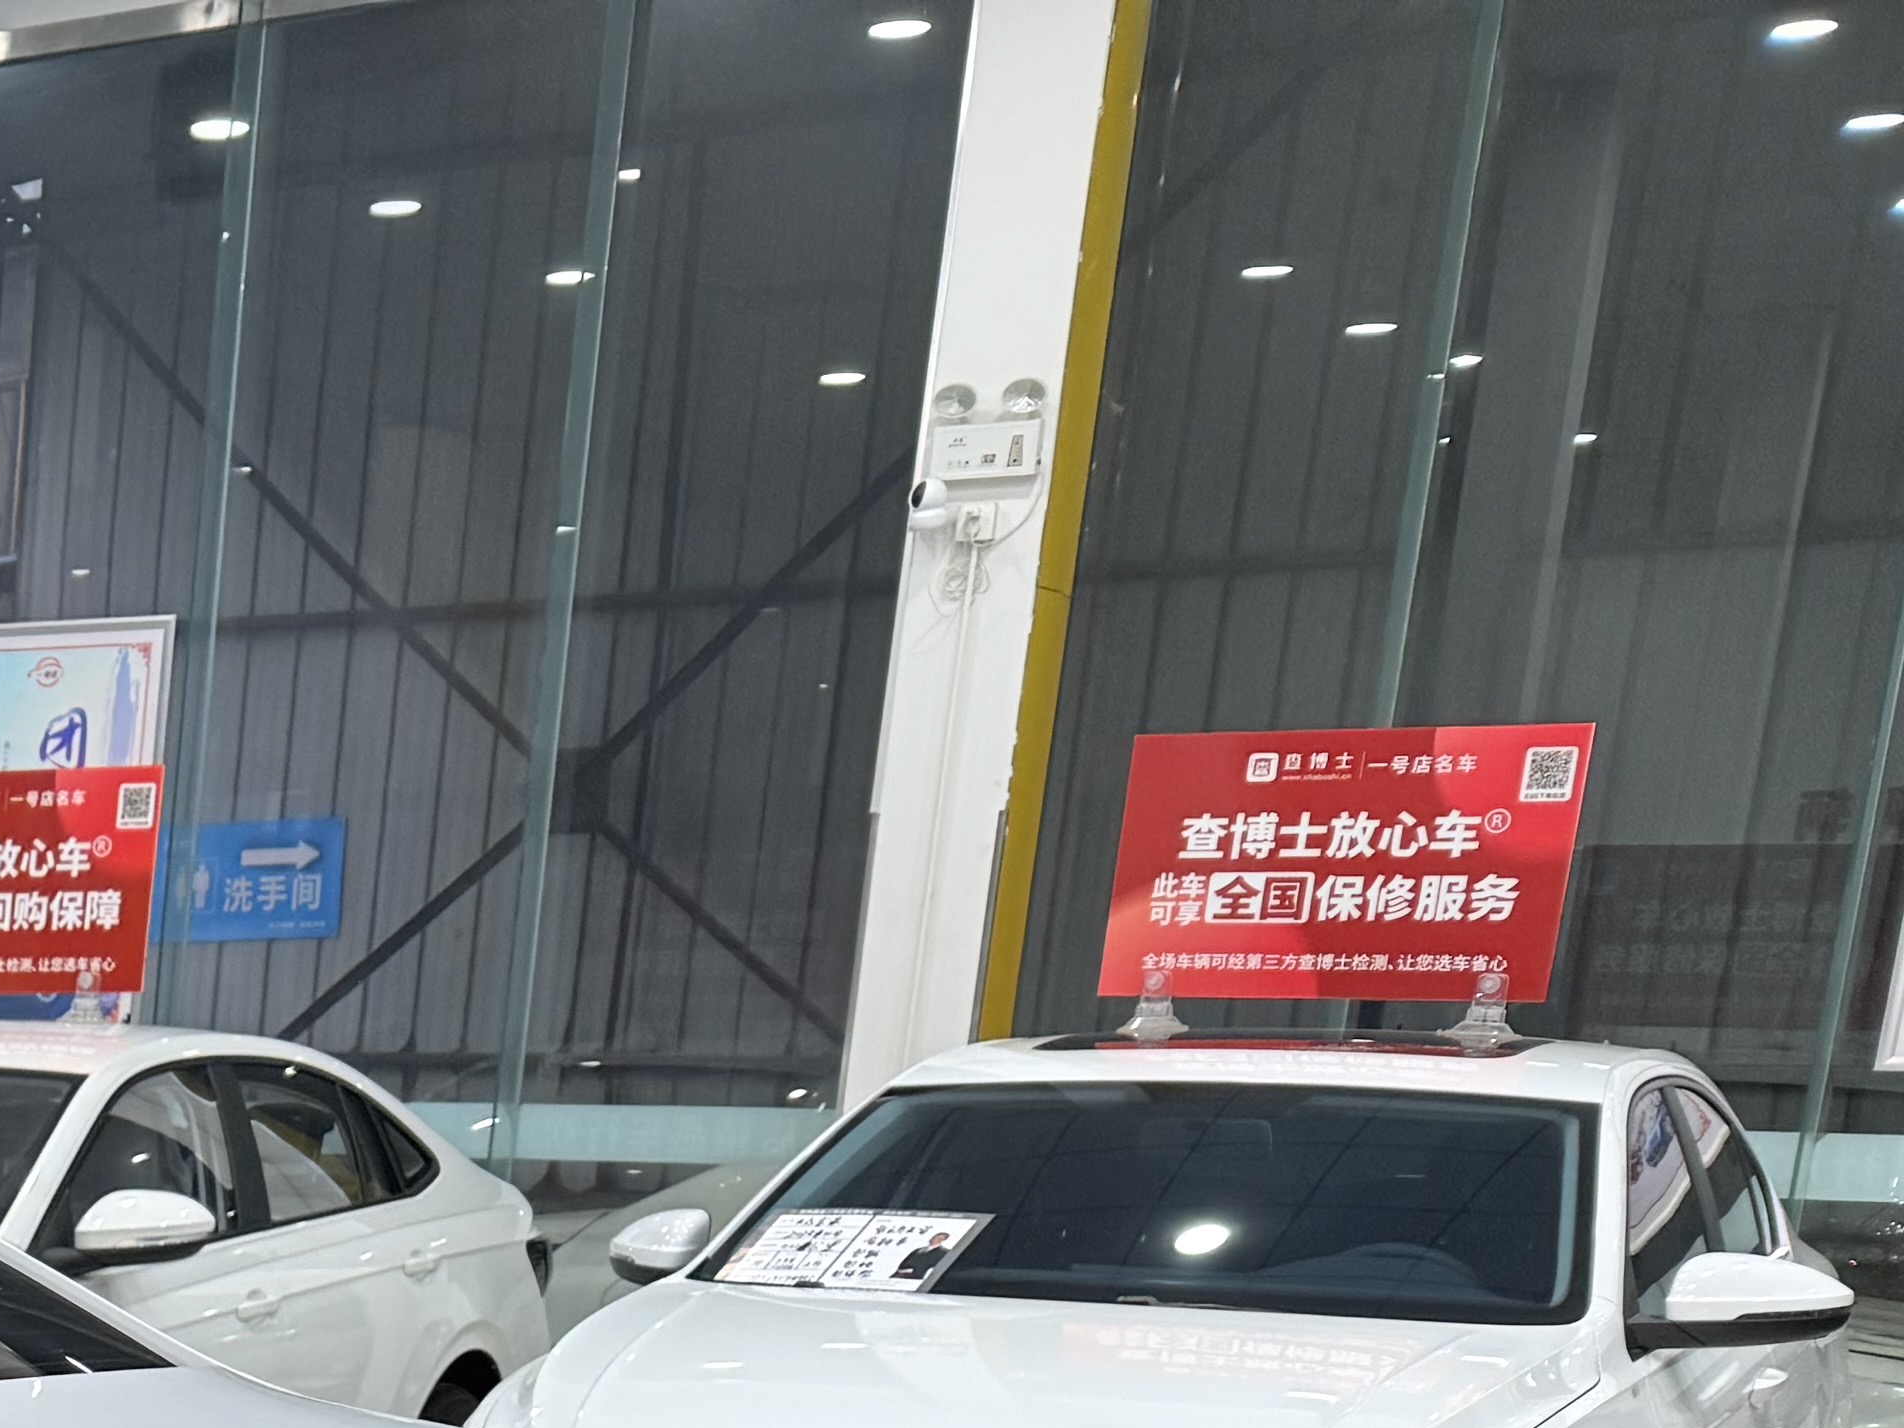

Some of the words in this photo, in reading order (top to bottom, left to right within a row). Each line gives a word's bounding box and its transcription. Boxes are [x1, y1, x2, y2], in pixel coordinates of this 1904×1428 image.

[1367, 753, 1479, 775] 一号店名车
[9, 789, 86, 808] 一号店名车
[223, 873, 323, 913] 洗手间
[1151, 872, 1207, 899] 此车
[1149, 901, 1204, 926] 可享
